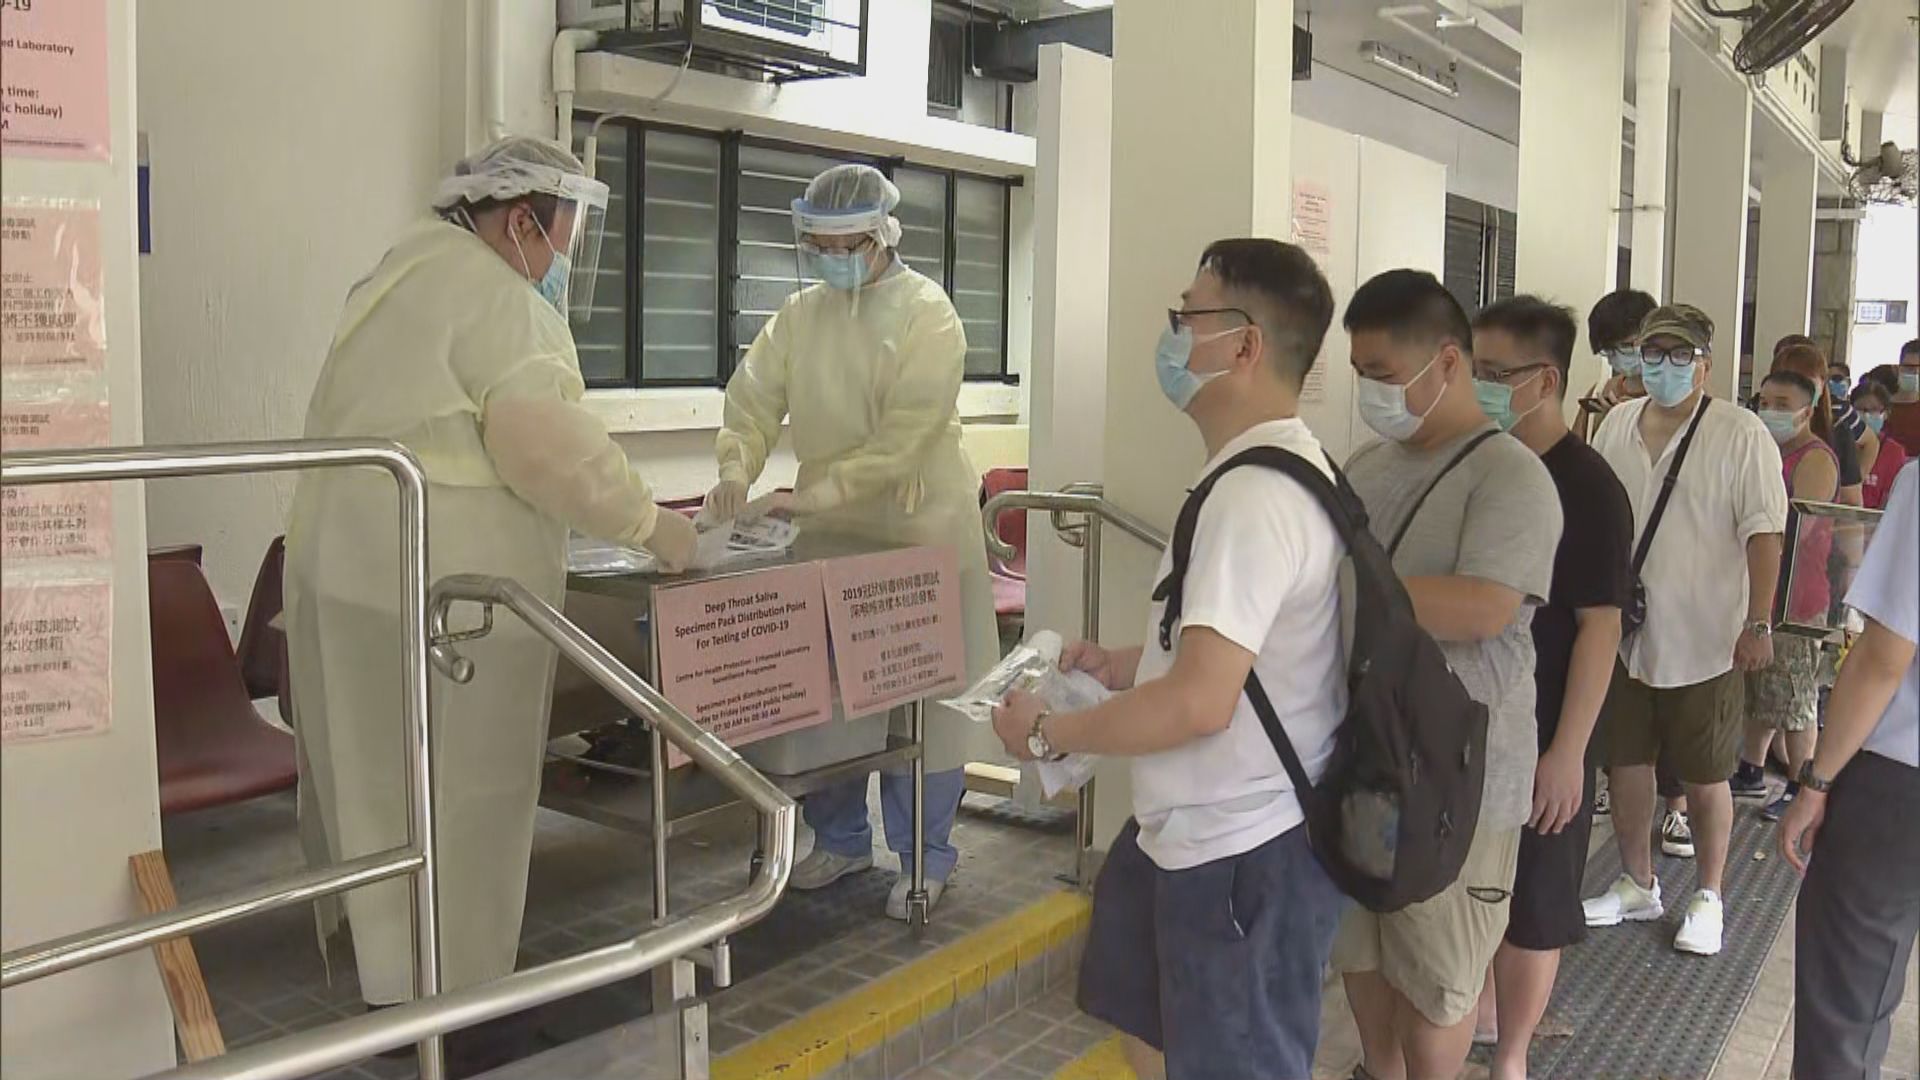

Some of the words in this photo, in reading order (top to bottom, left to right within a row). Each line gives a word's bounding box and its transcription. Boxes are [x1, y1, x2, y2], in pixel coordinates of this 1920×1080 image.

[16, 40, 74, 56] Laboratory
[15, 103, 63, 119] holiday)
[705, 602, 726, 614] Deep
[728, 595, 754, 609] Throat
[755, 592, 779, 603] Saliva
[675, 621, 717, 639] Specimen
[718, 615, 737, 628] Pack
[738, 605, 785, 624] Distribution
[786, 600, 807, 614] Point
[696, 639, 710, 650] For
[712, 631, 740, 646] Testing
[741, 627, 750, 639] of
[751, 620, 789, 637] COVID-19
[781, 645, 810, 657] Laboratory
[696, 699, 726, 713] Specimen
[727, 694, 741, 706] pack
[743, 685, 777, 700] distribution
[720, 707, 739, 719] Friday
[740, 700, 761, 714] (except
[782, 688, 806, 702] holiday)
[770, 706, 781, 716] AM
